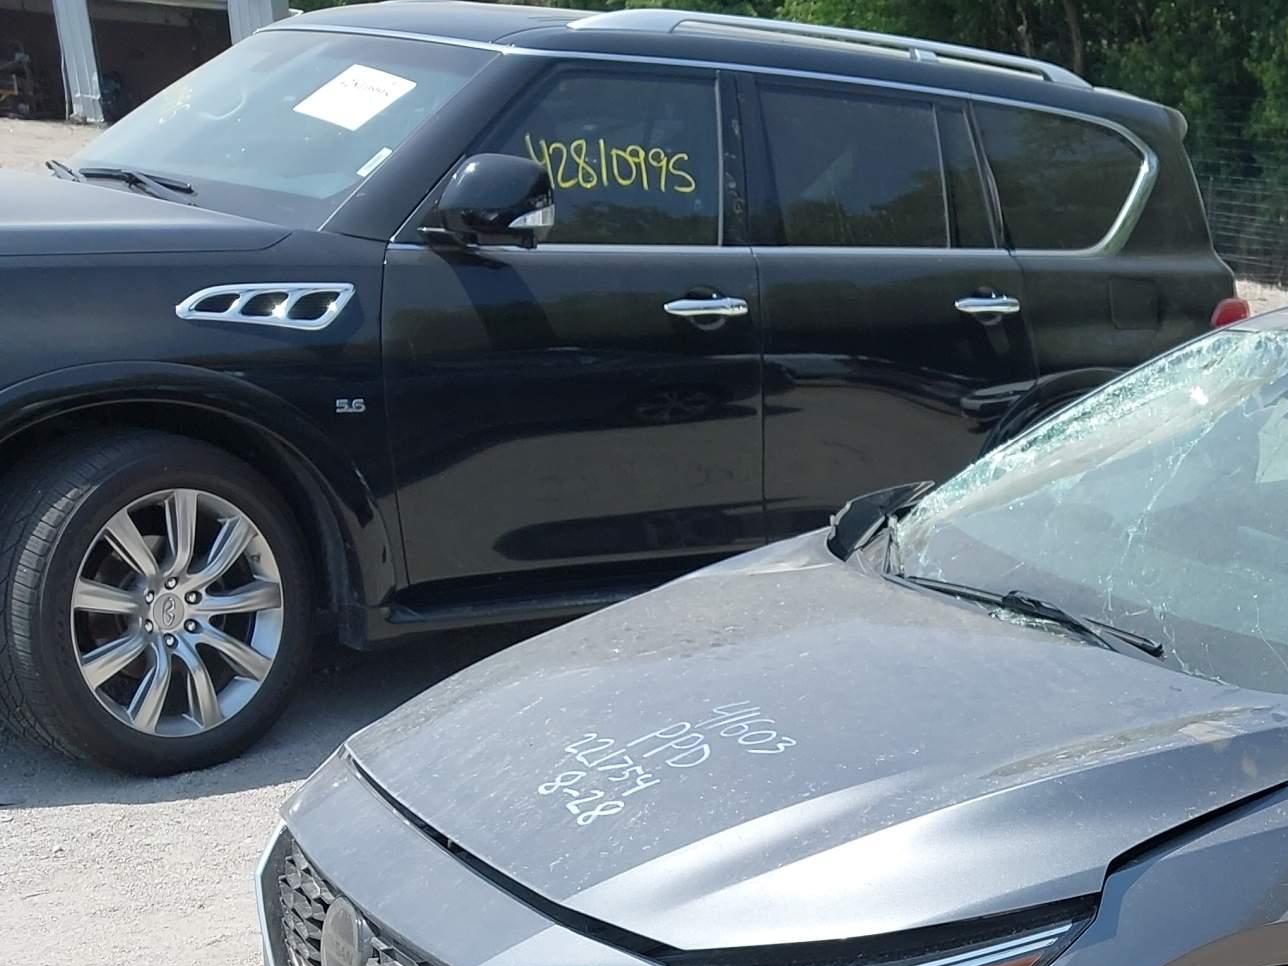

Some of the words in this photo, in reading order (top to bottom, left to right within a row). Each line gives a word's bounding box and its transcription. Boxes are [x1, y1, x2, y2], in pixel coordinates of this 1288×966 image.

[525, 133, 696, 193] 42810995
[626, 722, 711, 768] PPD
[694, 700, 798, 754] 41603
[538, 771, 625, 826] 8-28
